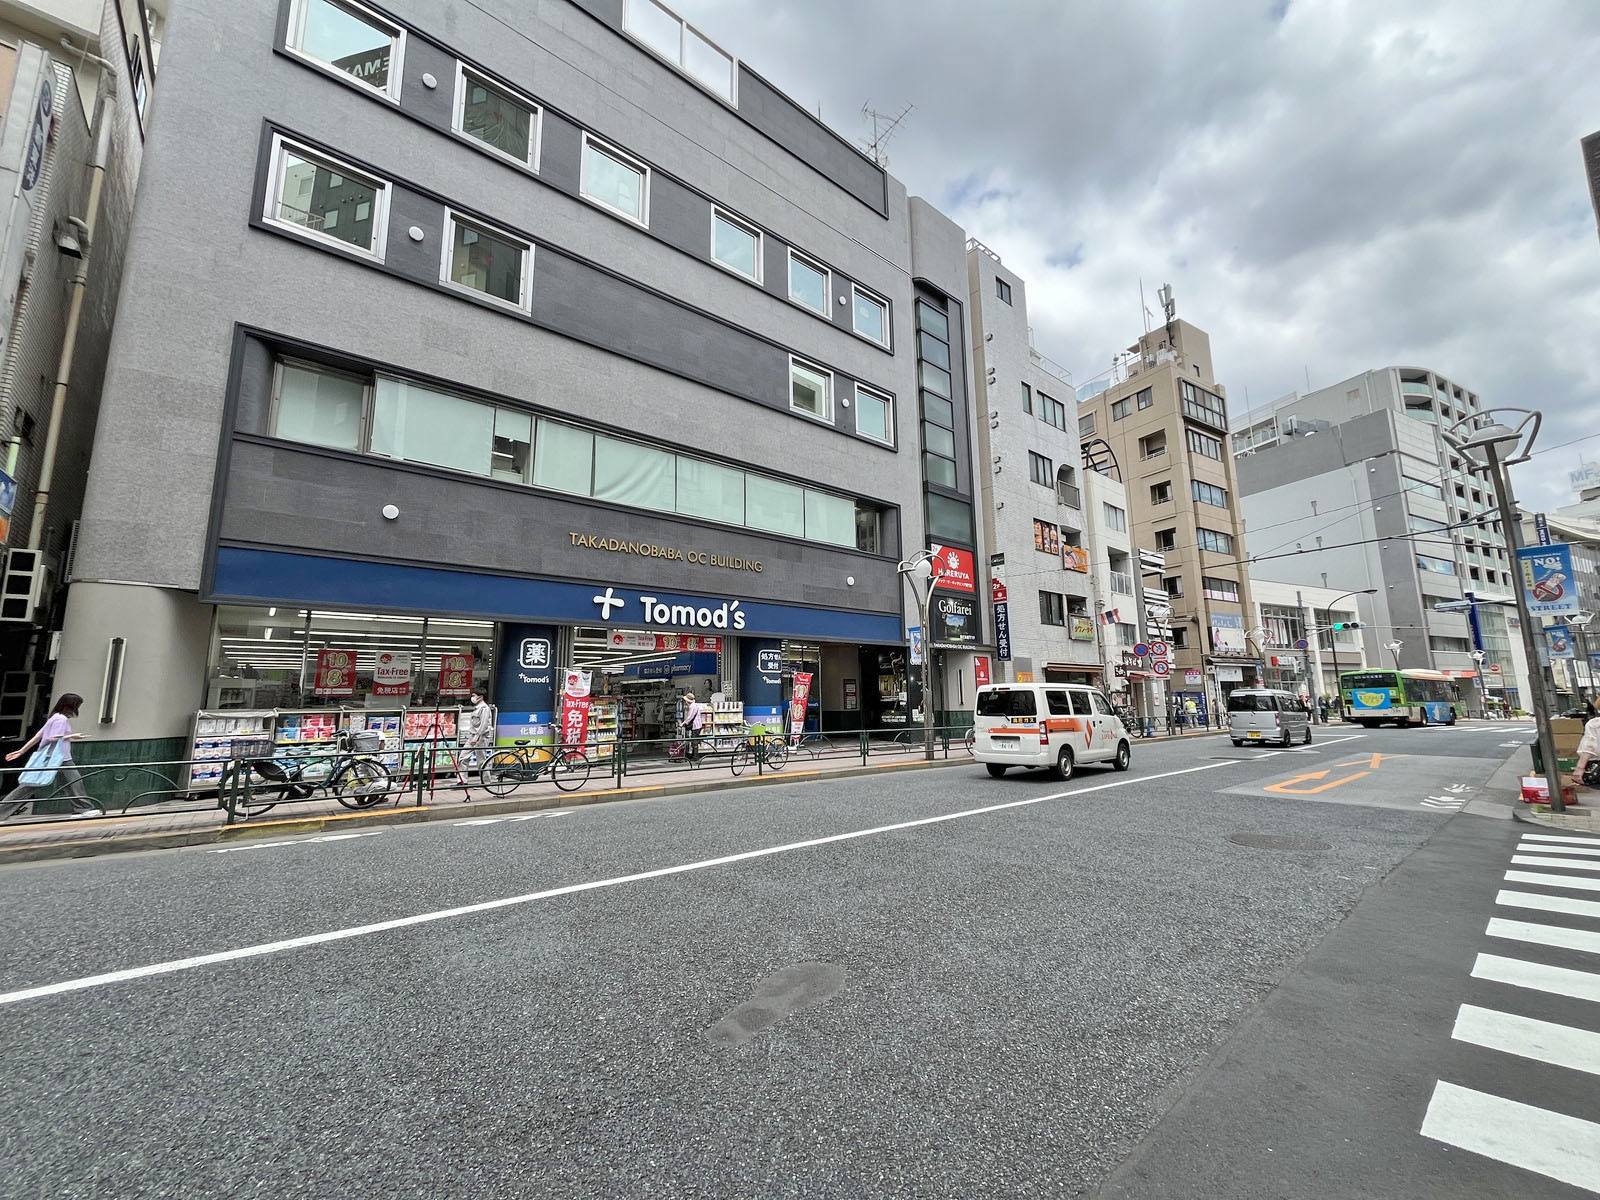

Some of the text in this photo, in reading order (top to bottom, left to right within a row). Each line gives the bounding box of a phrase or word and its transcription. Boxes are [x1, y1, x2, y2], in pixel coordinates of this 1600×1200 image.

[569, 532, 763, 573] TAKADANOBABA OC BUILDING
[640, 596, 746, 630] Tomod's
[938, 599, 972, 616] Golfarei
[1530, 603, 1572, 611] STREET
[996, 604, 1009, 657] 処方せん受付
[327, 652, 348, 668] 10
[525, 642, 546, 664] 薬
[377, 667, 408, 676] Tax-Free
[671, 664, 692, 674] pharmacy
[767, 662, 779, 670] 受付
[327, 669, 342, 687] 8
[522, 675, 550, 683] Tomod's
[520, 726, 544, 735] 化粧品
